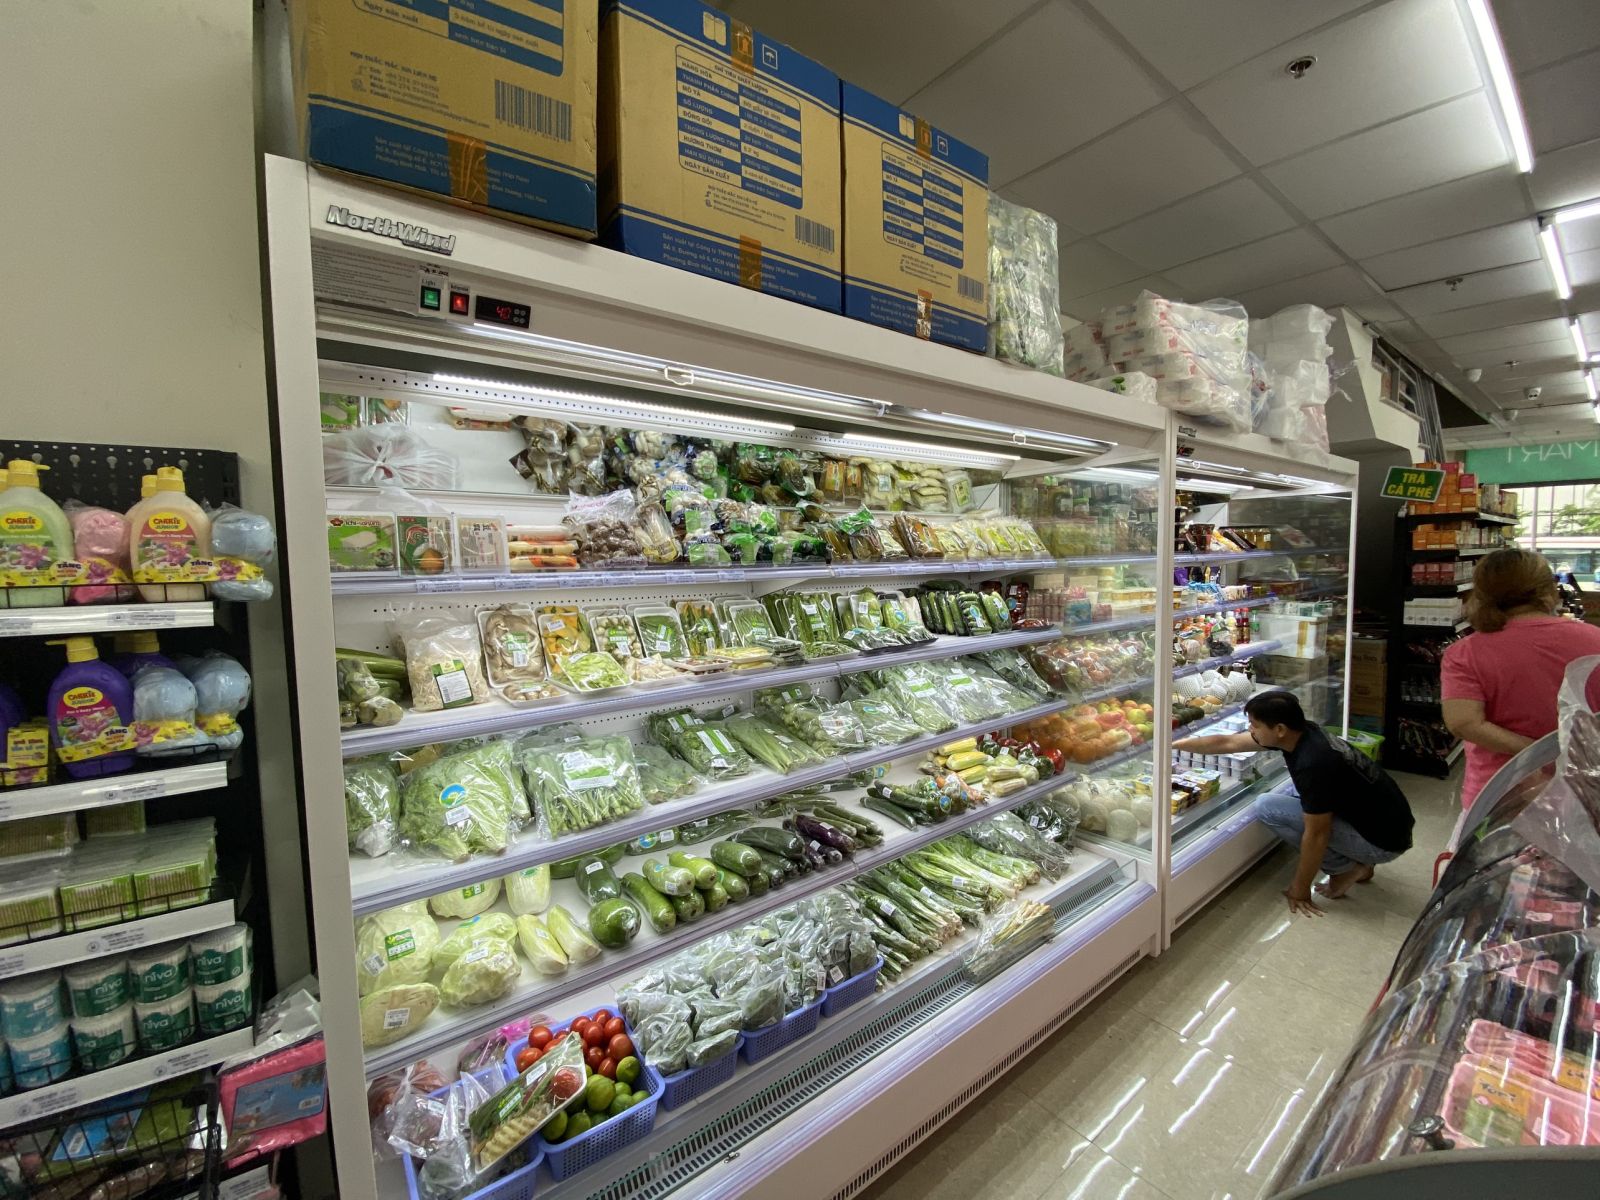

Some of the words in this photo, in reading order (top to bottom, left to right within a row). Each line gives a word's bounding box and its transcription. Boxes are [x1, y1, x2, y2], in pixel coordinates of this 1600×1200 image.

[326, 204, 456, 251] NorthWind
[1402, 471, 1426, 485] TRÀ
[1387, 482, 1404, 496] CÀ
[1407, 485, 1433, 499] PHÊ
